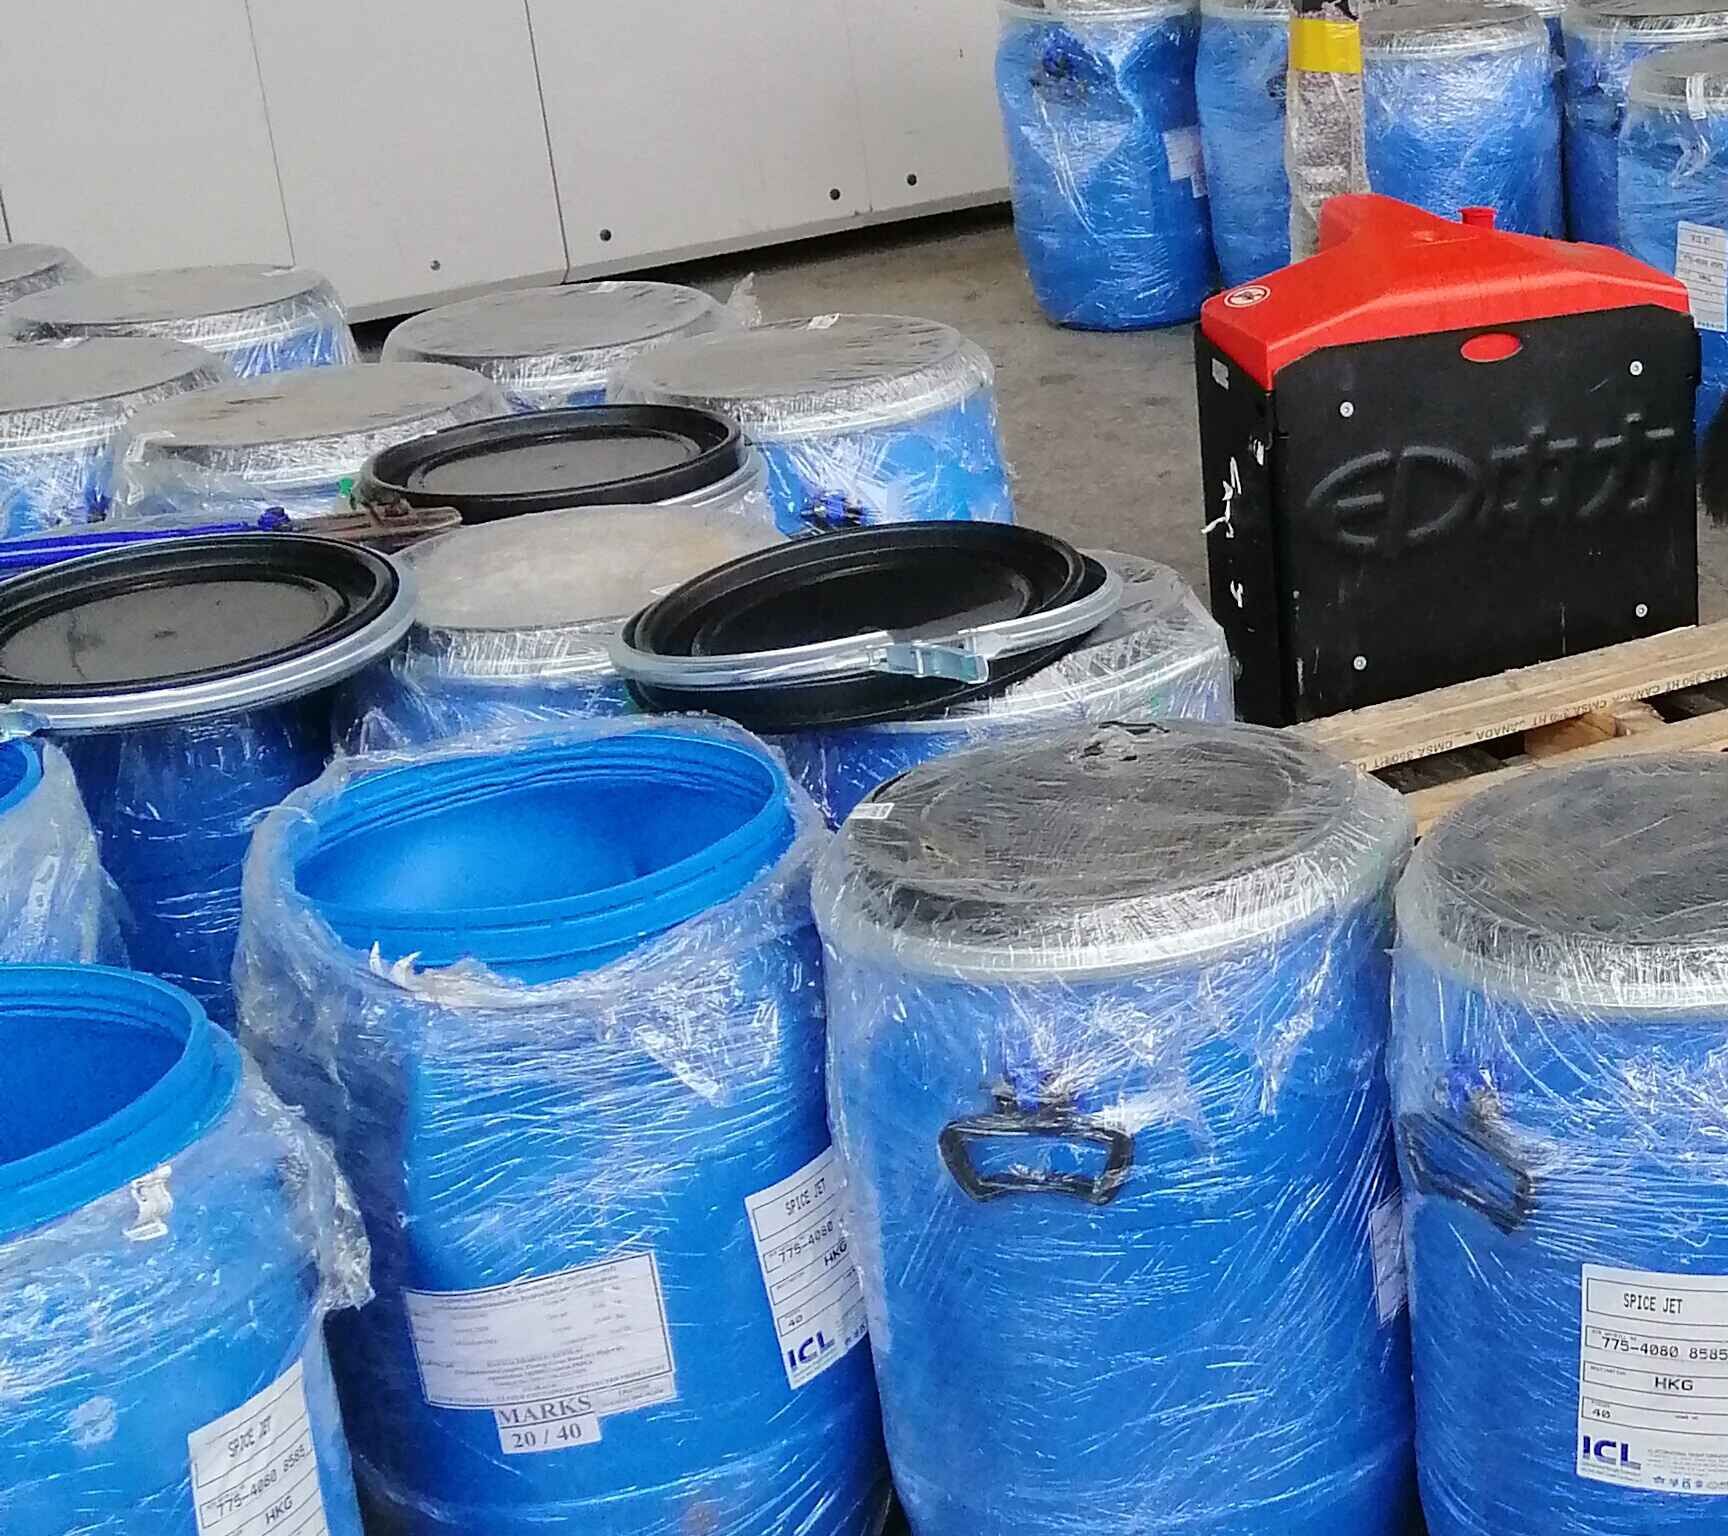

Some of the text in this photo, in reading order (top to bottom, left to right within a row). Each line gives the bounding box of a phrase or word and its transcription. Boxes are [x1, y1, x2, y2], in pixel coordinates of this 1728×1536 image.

[785, 1177, 827, 1216] SPICE JET
[824, 1238, 848, 1266] HKG
[1623, 1293, 1683, 1315] SPICE JET
[786, 1329, 836, 1371] ICL
[1601, 1335, 1680, 1359] 775-4080
[1688, 1346, 1728, 1361] 8585
[1654, 1376, 1694, 1392] HKG
[498, 1395, 593, 1425] MARKS
[1591, 1407, 1612, 1419] 40
[227, 1429, 256, 1459] SPICE
[512, 1424, 582, 1448] 20 / 40
[1583, 1435, 1642, 1471] ICL
[264, 1494, 294, 1526] HKG
